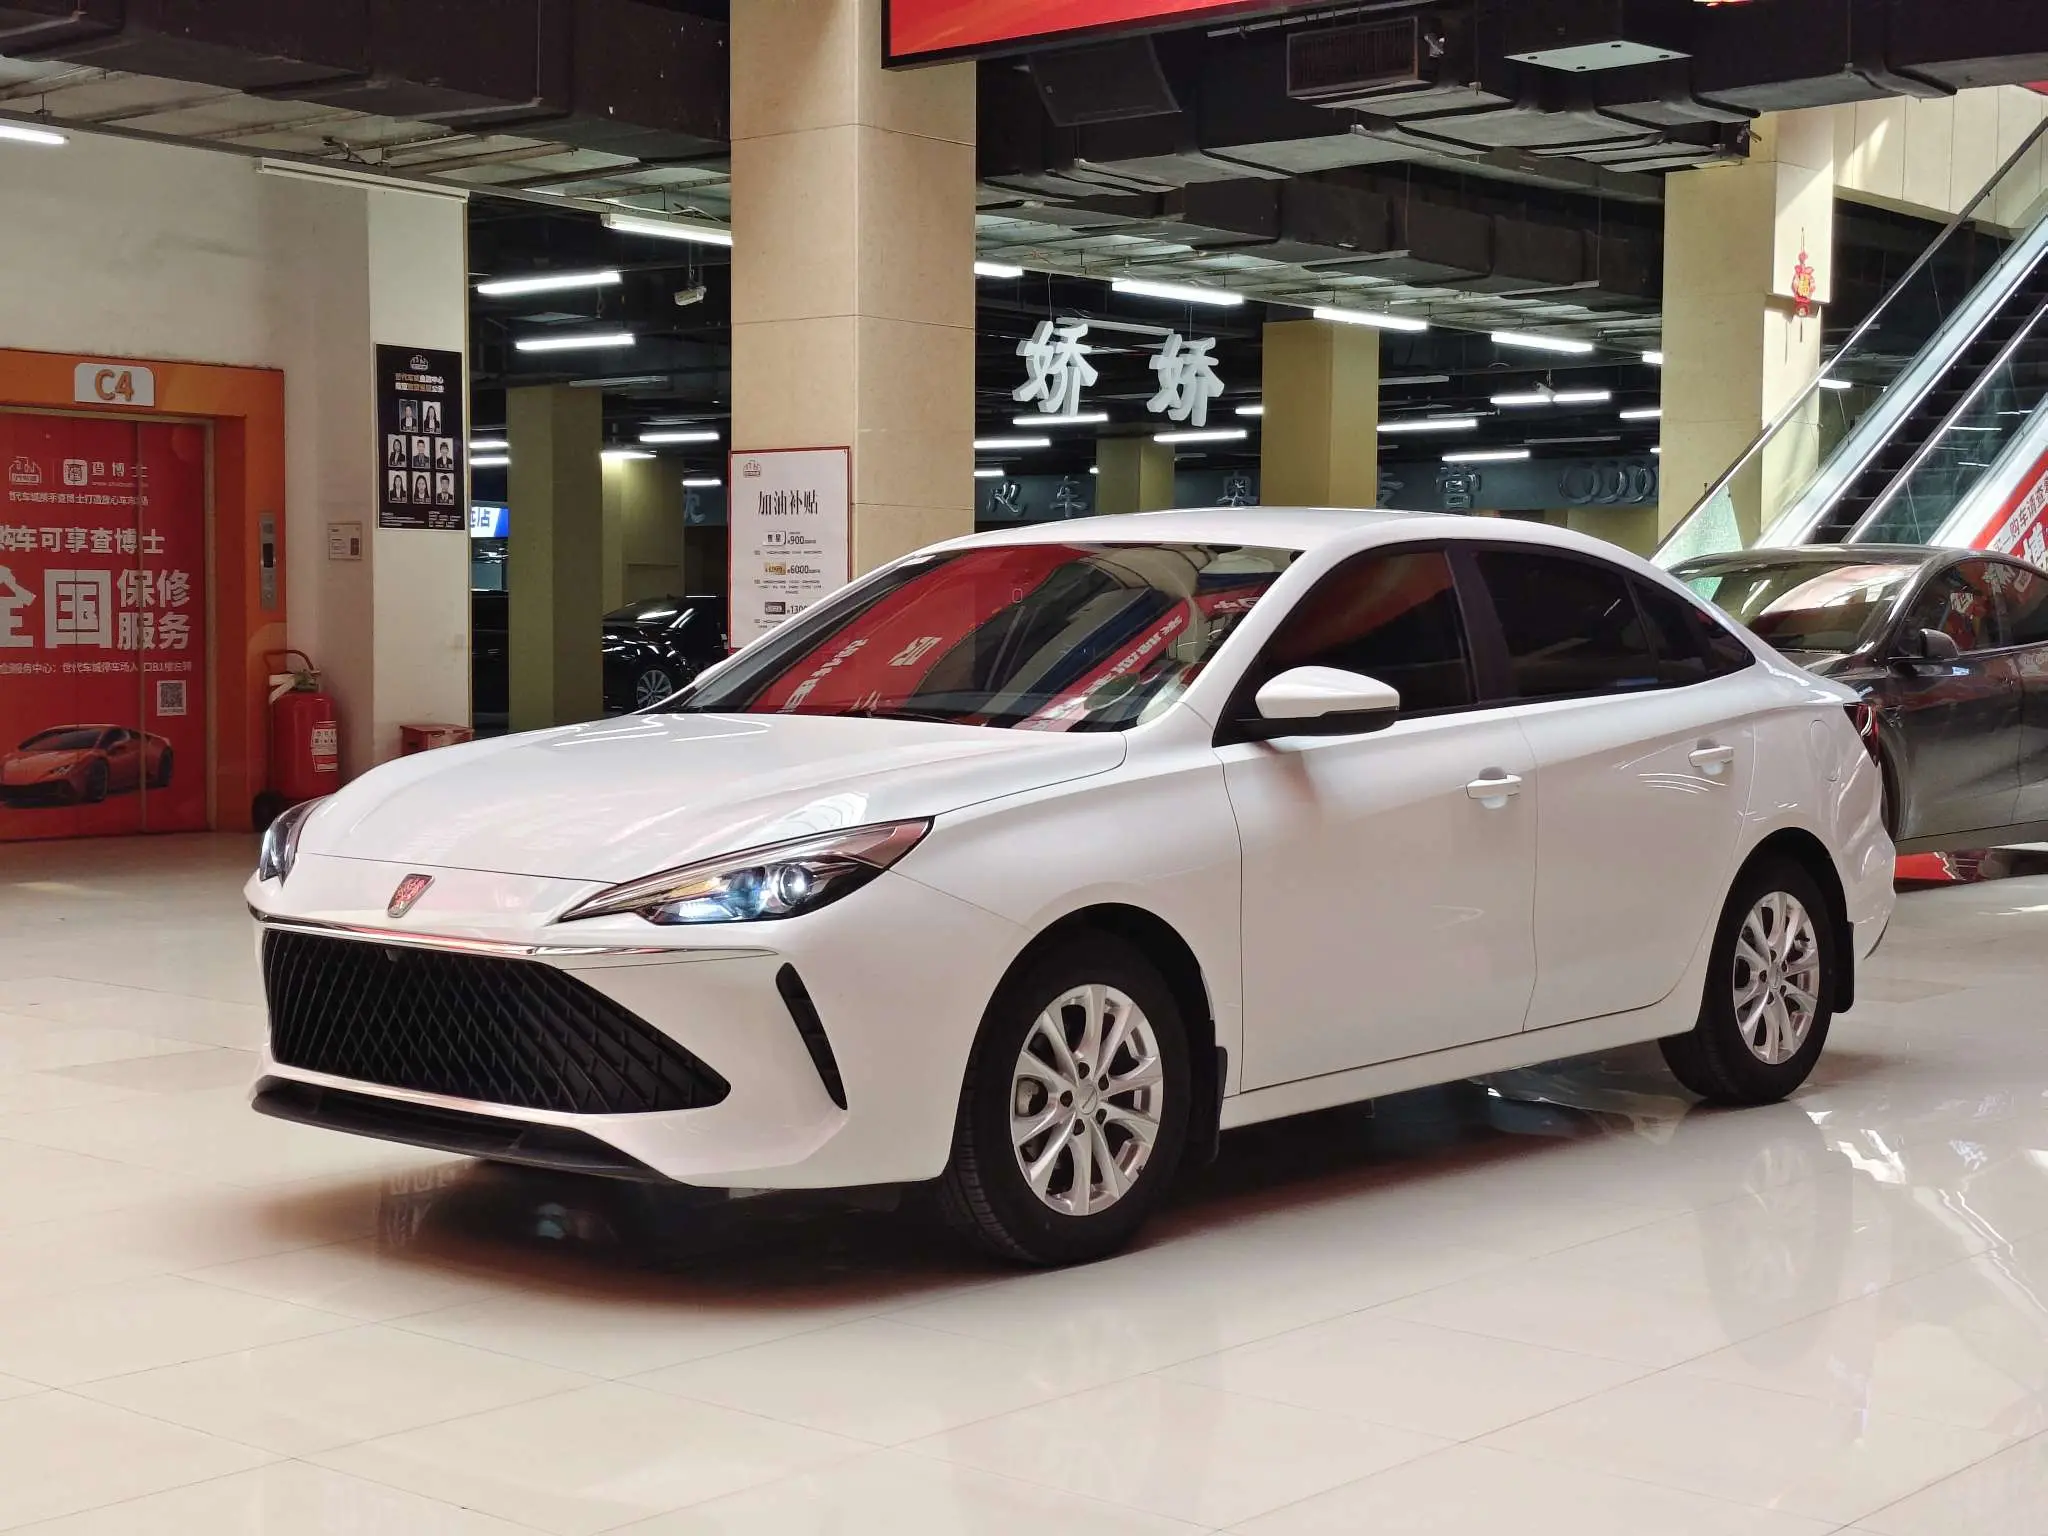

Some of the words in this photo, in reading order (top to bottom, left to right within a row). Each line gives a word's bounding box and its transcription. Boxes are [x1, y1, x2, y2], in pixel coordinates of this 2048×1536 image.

[94, 368, 134, 402] C4
[758, 489, 818, 516] 加油补贴
[117, 568, 190, 608] 保修
[117, 611, 191, 650] 服务
